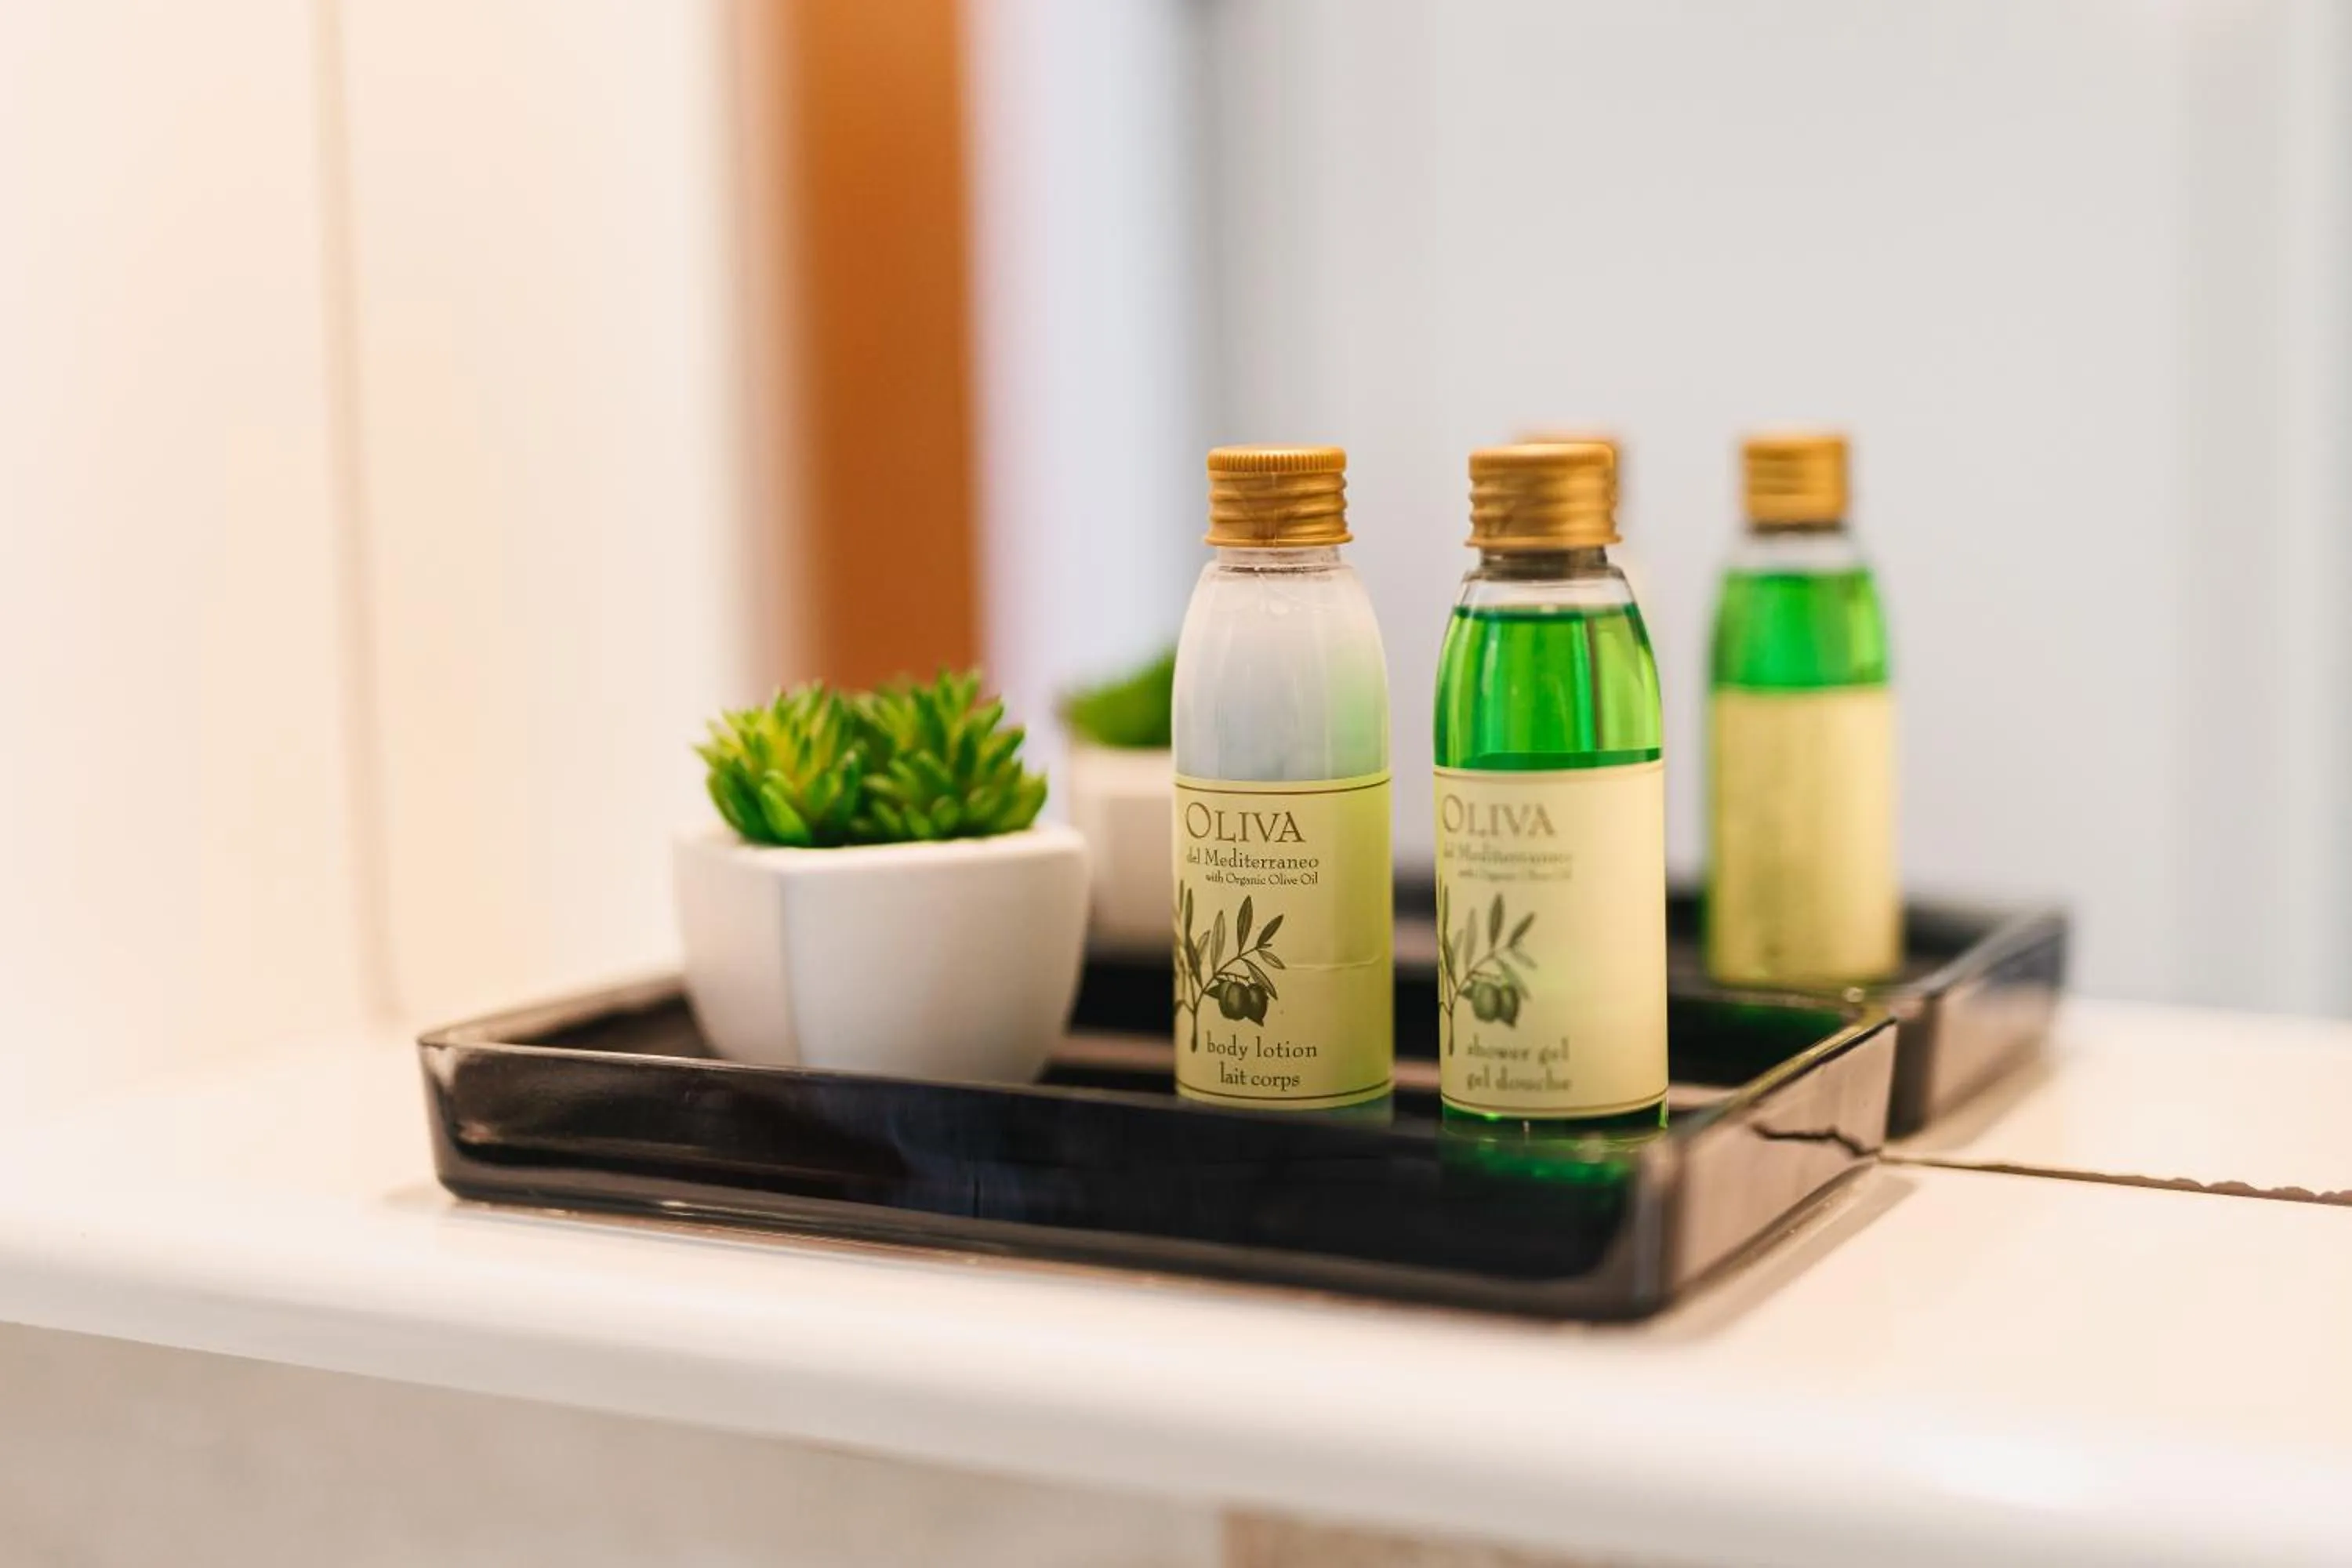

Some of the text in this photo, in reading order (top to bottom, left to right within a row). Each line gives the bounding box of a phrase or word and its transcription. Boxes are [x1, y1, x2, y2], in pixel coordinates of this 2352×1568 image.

[1185, 801, 1305, 843] OLIVA
[1441, 793, 1556, 837] OLIVA
[1186, 846, 1319, 869] del Mediterraneo
[1206, 870, 1319, 886] with Organic Olive Oil
[1207, 1030, 1318, 1060] body lotion
[1219, 1060, 1301, 1092] lait corps
